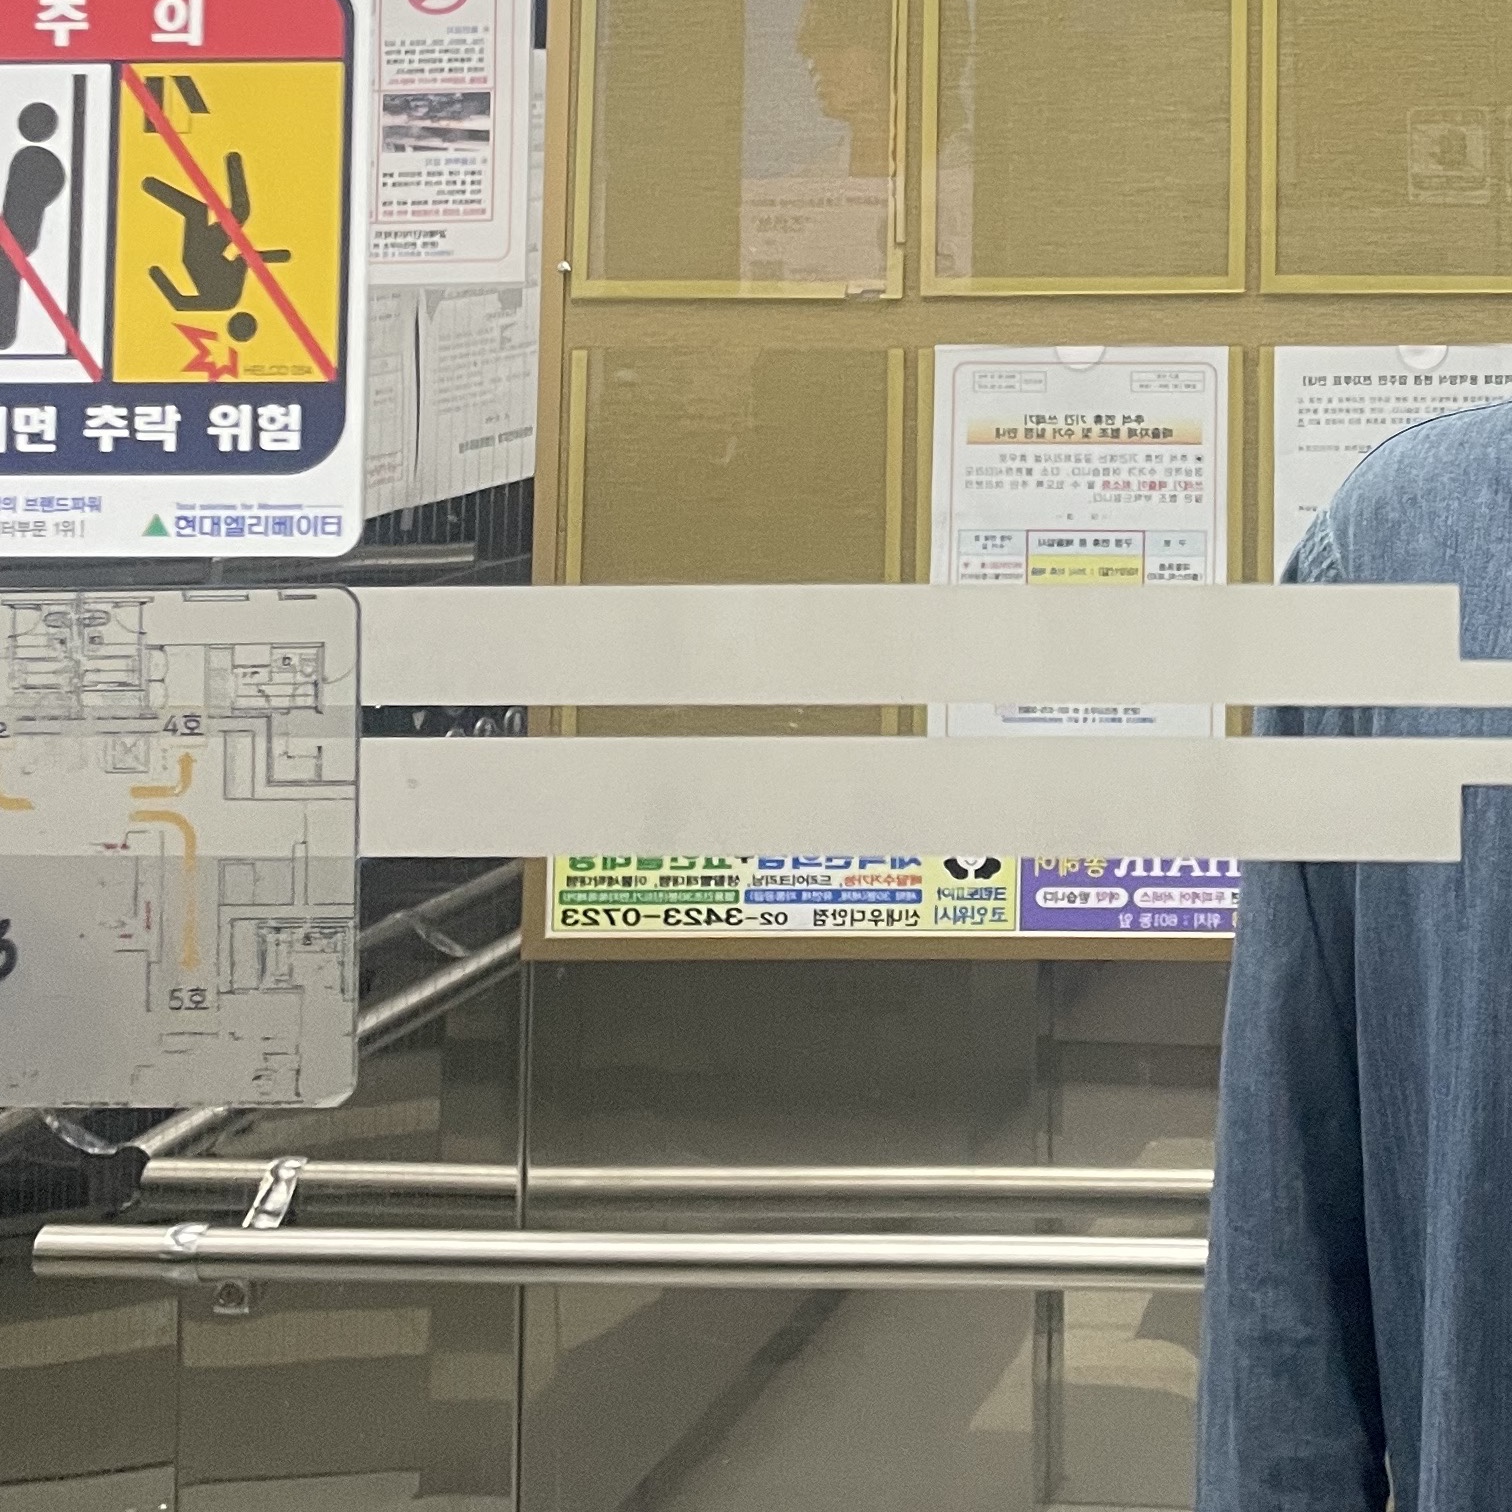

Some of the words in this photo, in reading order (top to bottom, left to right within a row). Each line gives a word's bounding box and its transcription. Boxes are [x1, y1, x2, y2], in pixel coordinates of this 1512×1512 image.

[0, 406, 56, 452] 면
[83, 404, 181, 452] 추락
[207, 404, 301, 451] 위험
[174, 515, 342, 537] 현대엘리베이터
[163, 714, 204, 737] 4호
[168, 987, 210, 1011] 5호
